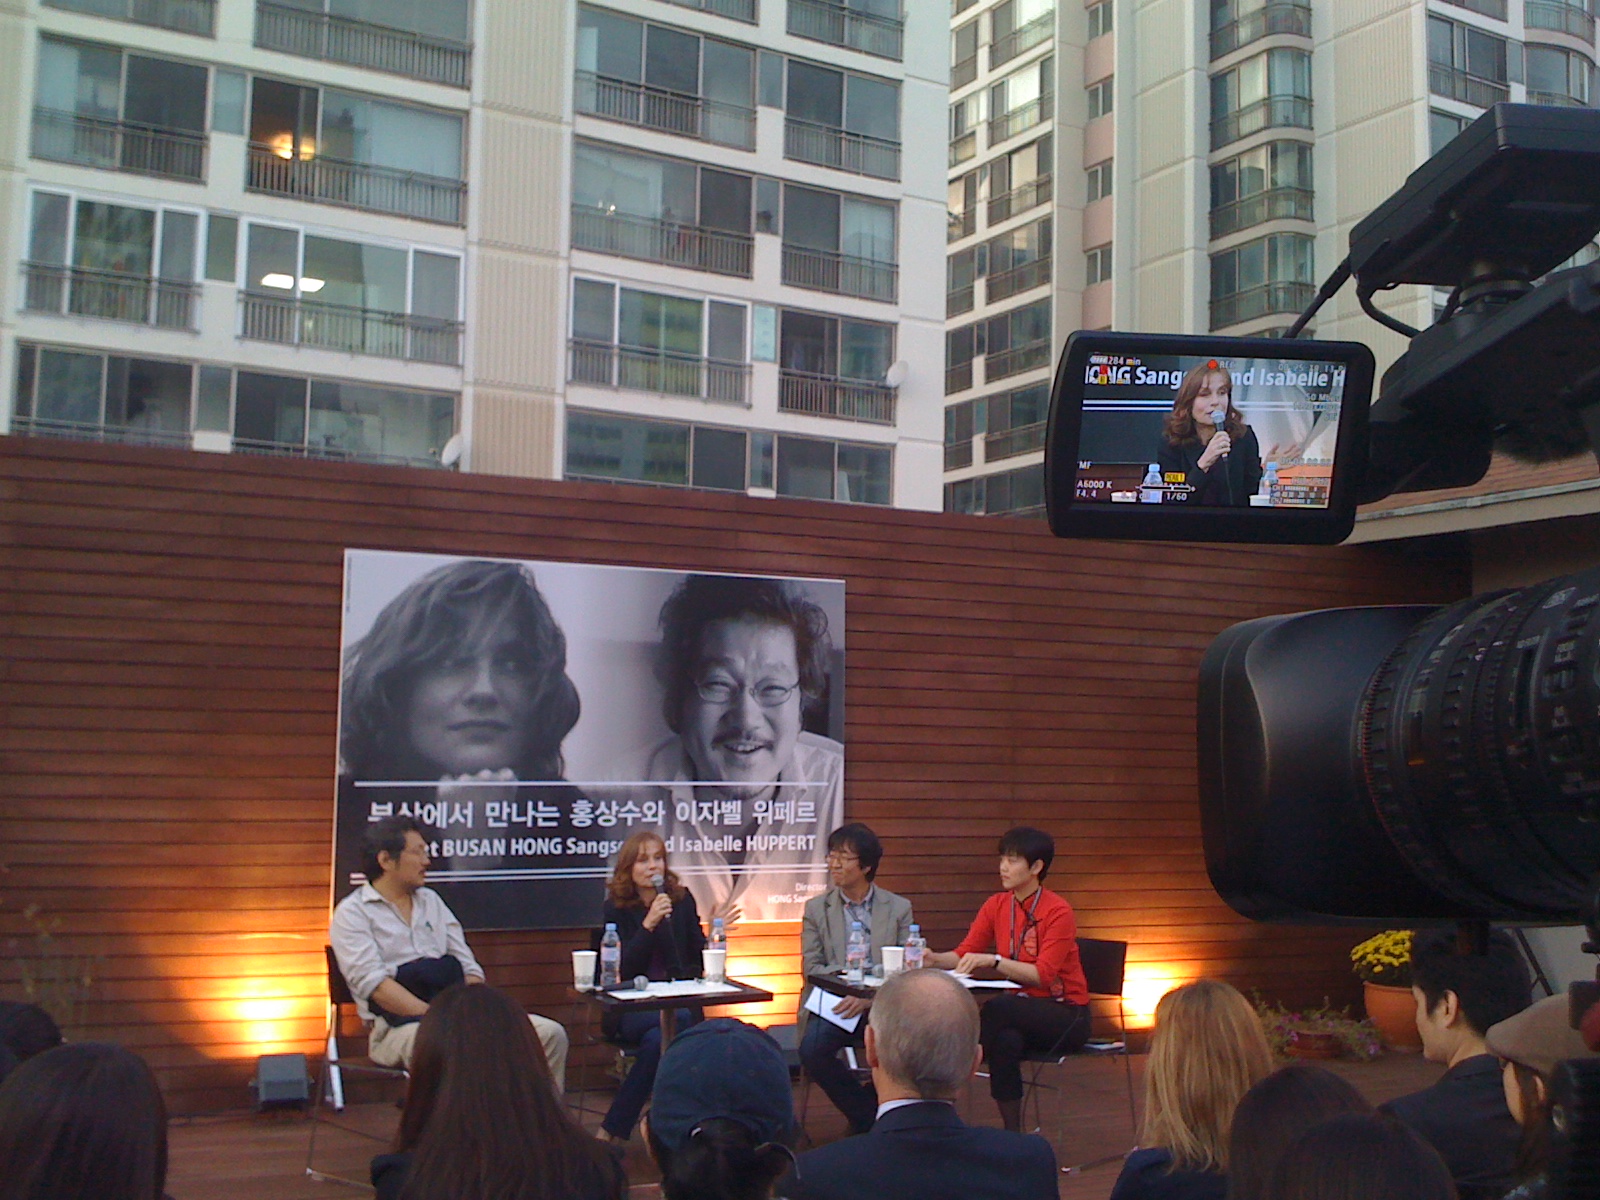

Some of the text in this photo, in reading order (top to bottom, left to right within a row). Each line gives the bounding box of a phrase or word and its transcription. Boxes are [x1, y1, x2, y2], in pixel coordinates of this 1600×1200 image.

[1135, 366, 1188, 390] Sang
[1231, 367, 1255, 386] nd
[1260, 368, 1328, 387] Isabelle
[485, 800, 561, 828] 만나는
[569, 800, 666, 828] 홍상수와
[676, 800, 742, 826] 이자벨
[752, 800, 817, 825] 위페르
[442, 838, 506, 858] BUSAN
[511, 838, 562, 856] HONG
[566, 837, 624, 858] Sangs
[680, 836, 743, 852] Isabelle
[746, 834, 816, 851] HUPPERT
